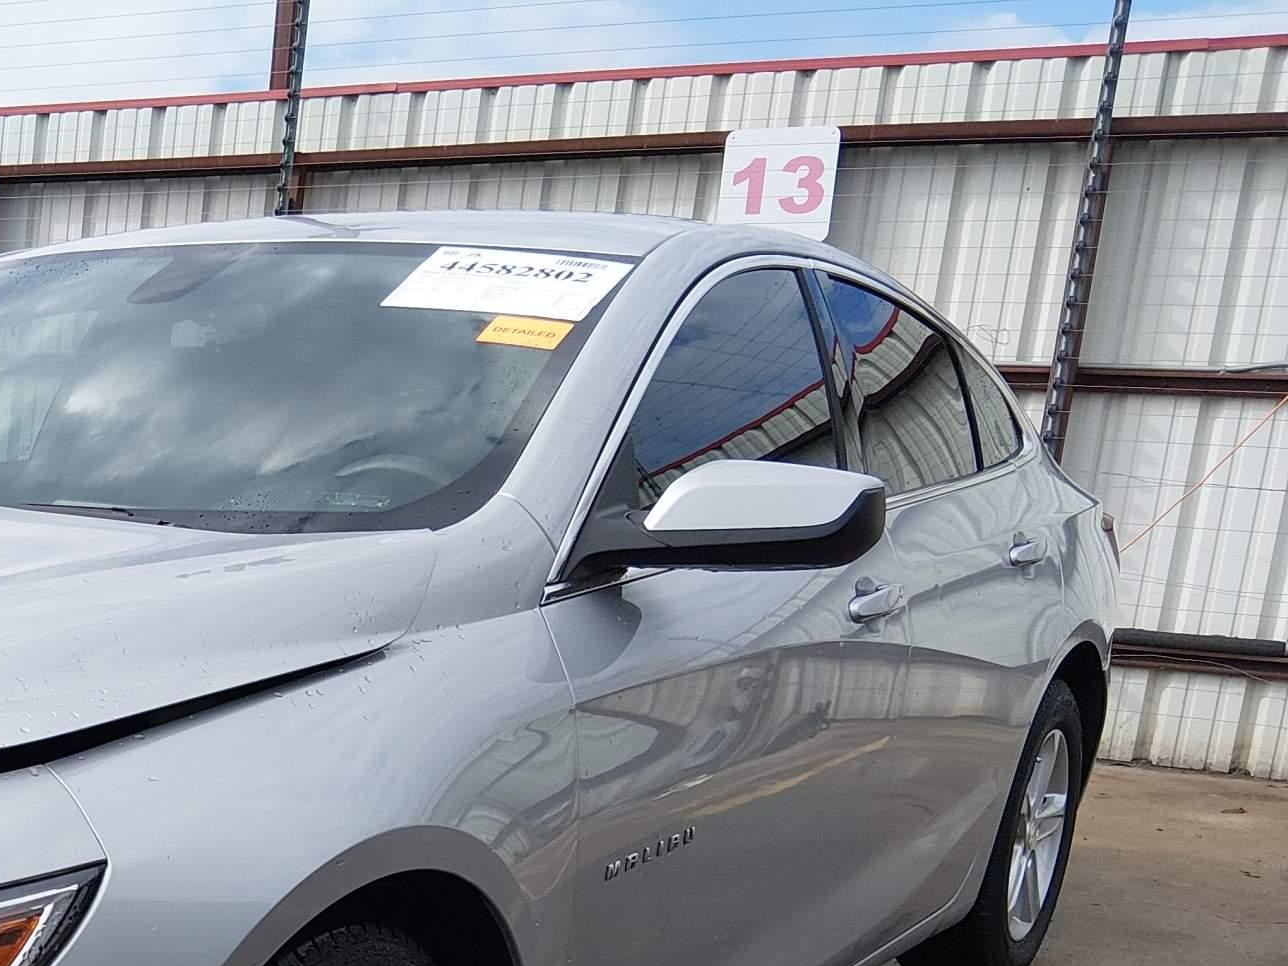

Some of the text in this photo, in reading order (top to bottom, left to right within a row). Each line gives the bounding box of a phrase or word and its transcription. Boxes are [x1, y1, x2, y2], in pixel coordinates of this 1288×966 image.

[732, 155, 825, 216] 13
[440, 260, 593, 283] 44582802
[492, 326, 557, 339] DETAILED
[604, 825, 696, 882] MALIBU
